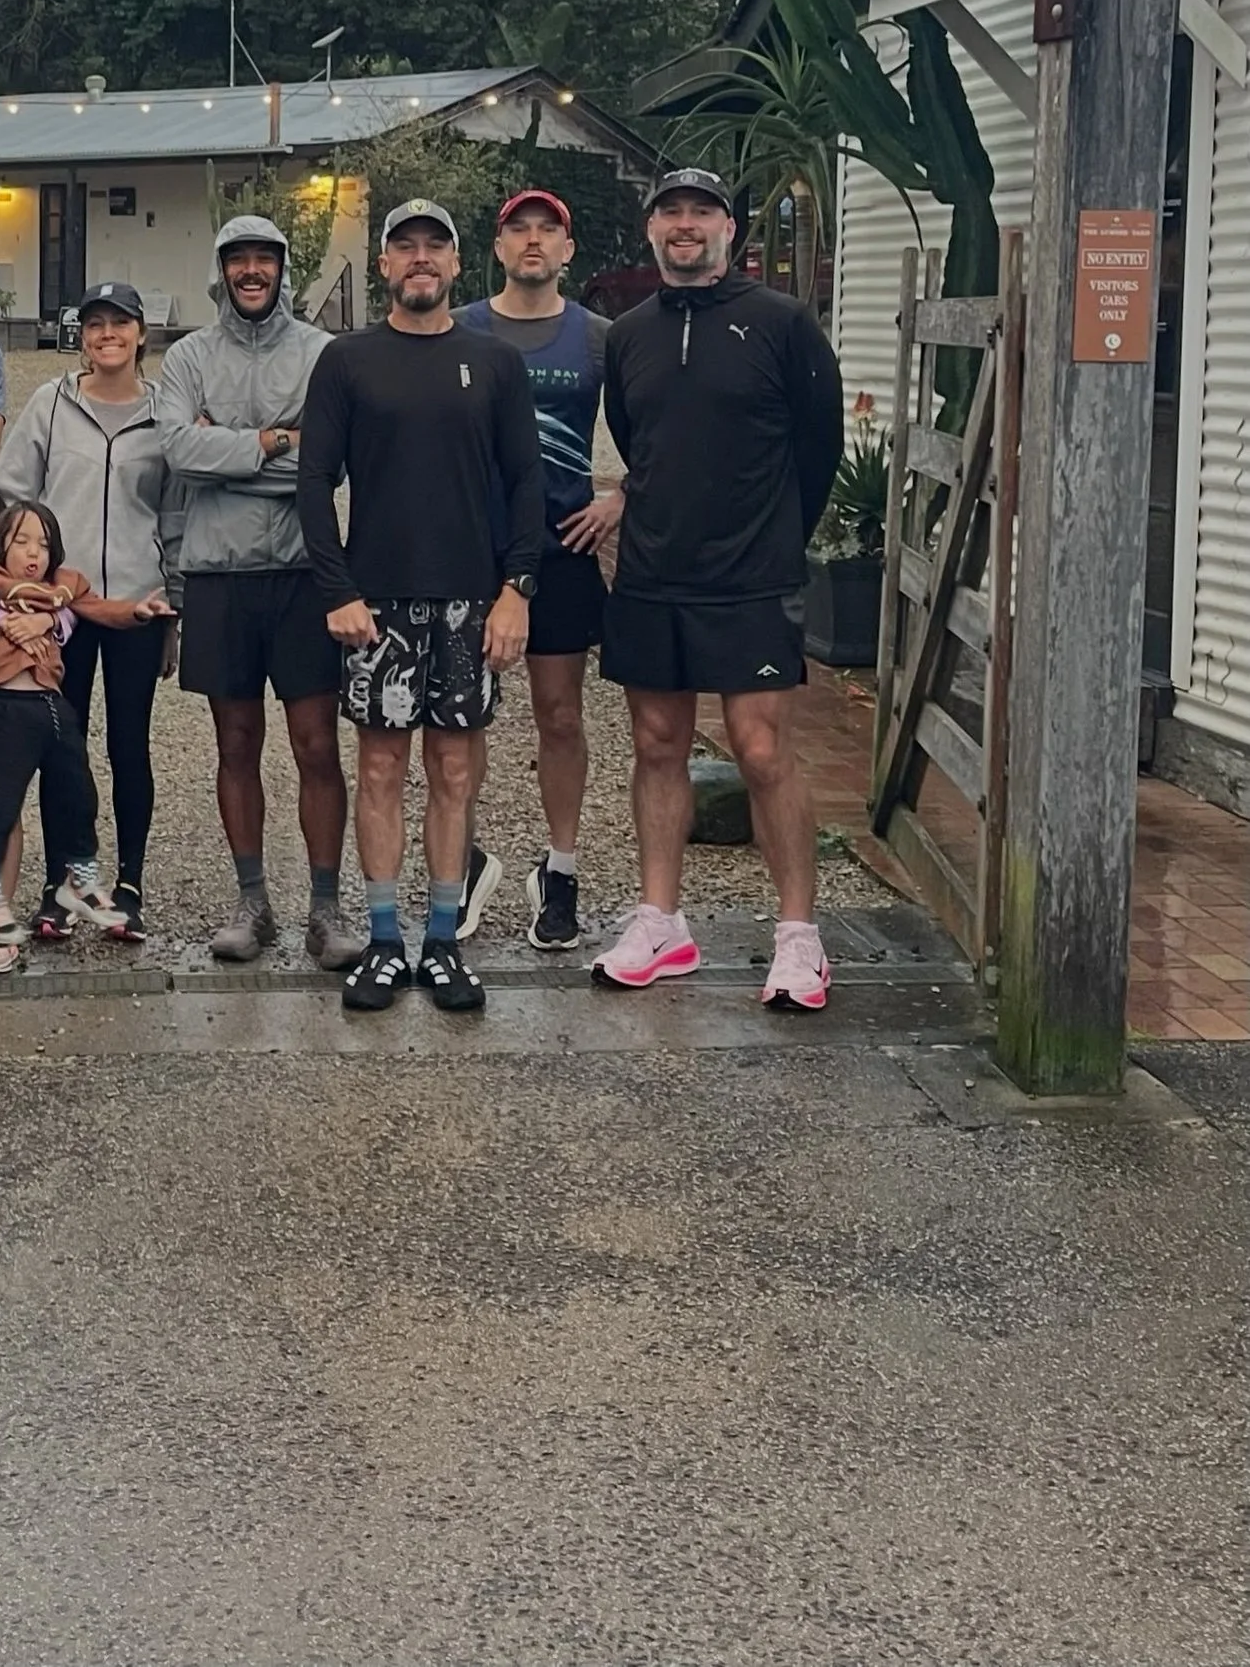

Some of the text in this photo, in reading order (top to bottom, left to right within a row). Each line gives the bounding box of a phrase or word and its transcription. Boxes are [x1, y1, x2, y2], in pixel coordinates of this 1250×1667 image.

[1086, 252, 1146, 266] NO ENTRY
[1089, 280, 1140, 292] VISITORS
[1100, 294, 1129, 307] CARS
[1099, 309, 1129, 321] ONLY
